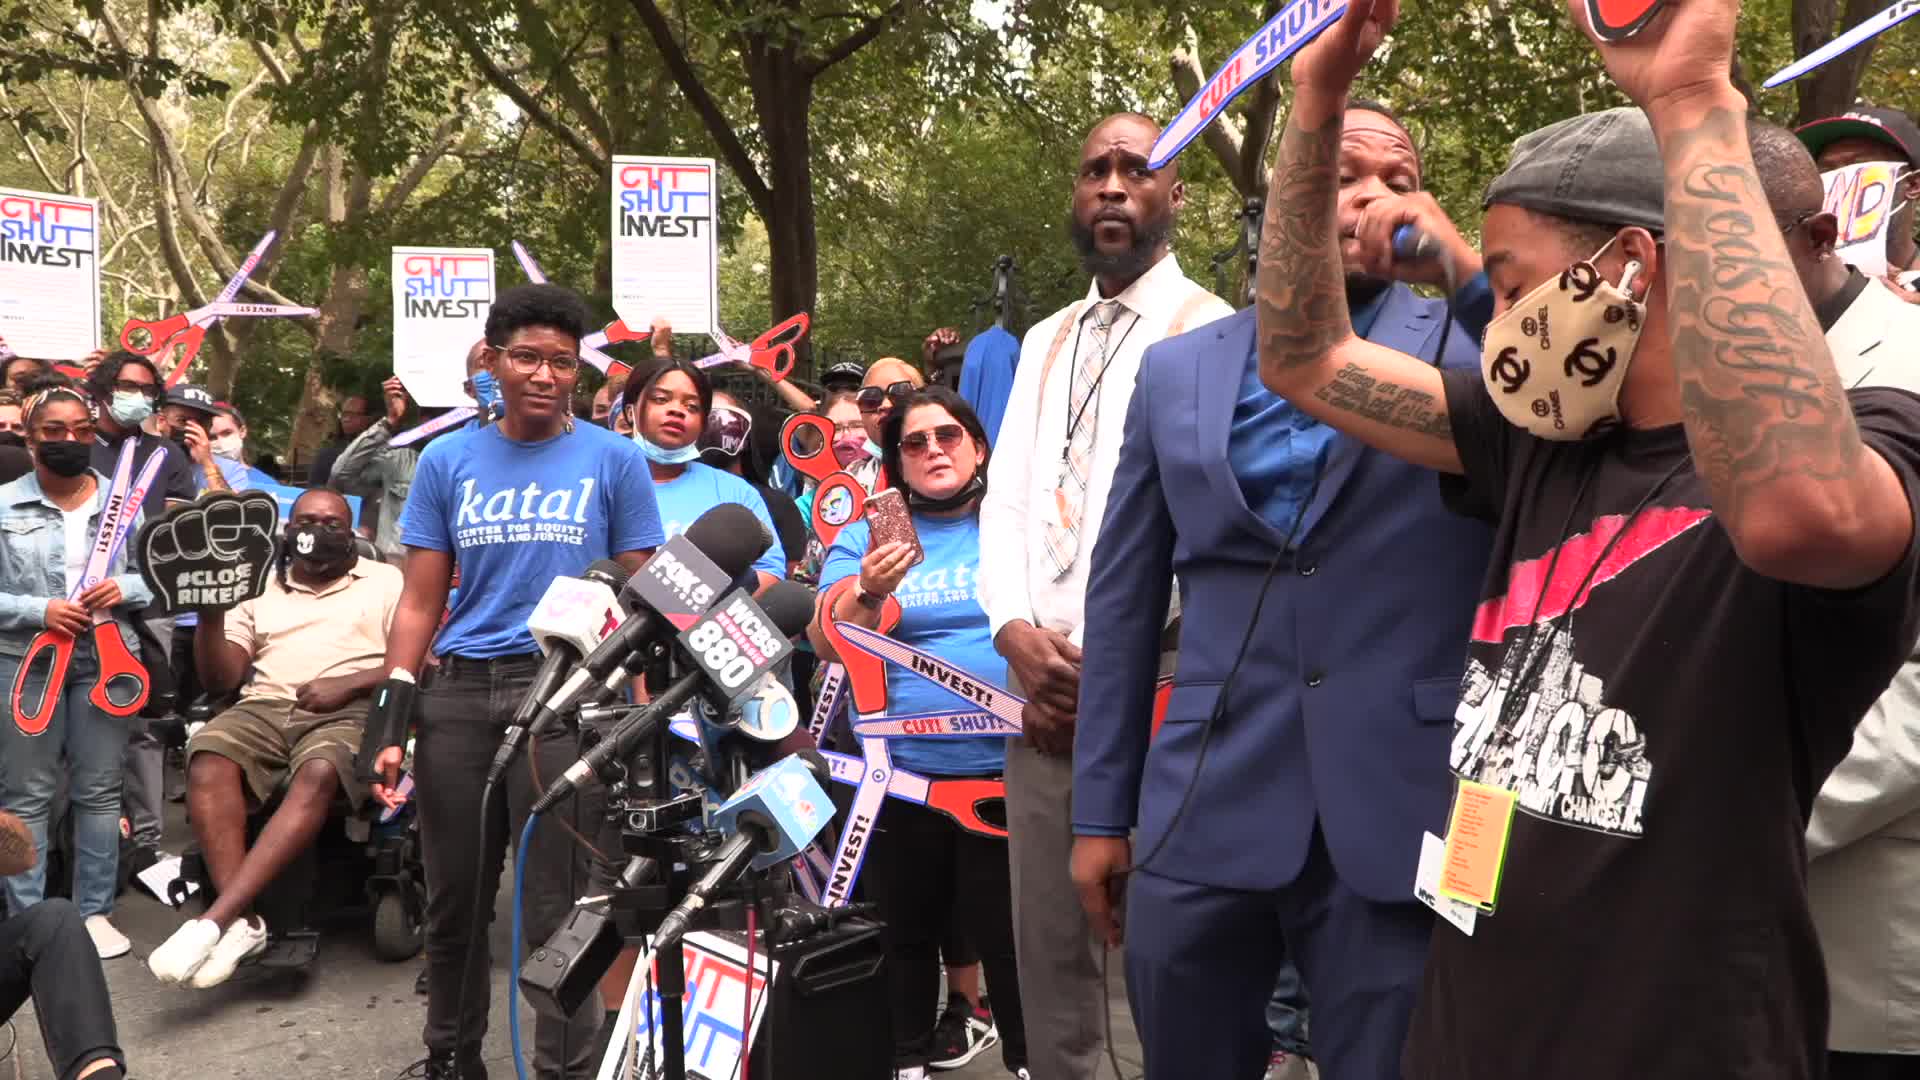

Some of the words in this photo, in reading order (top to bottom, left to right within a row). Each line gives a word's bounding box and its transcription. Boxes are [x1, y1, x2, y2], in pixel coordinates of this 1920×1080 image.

[1200, 57, 1242, 120] CUT!
[620, 180, 708, 213] SHUT
[1, 213, 93, 246] SHUT
[620, 206, 710, 238] INVEST
[1, 233, 93, 268] INVEST
[405, 269, 488, 297] SHUT
[405, 291, 490, 319] INVEST
[1538, 303, 1551, 351] CHANEL
[457, 478, 596, 527] katal
[96, 494, 123, 553] INVEST!
[457, 525, 502, 540] CENTER
[507, 523, 531, 534] FOR
[507, 532, 533, 545] AND
[532, 533, 584, 545] JUSTICE
[652, 550, 702, 595] FOX
[724, 598, 782, 658] WCBS
[688, 620, 754, 688] 880
[911, 655, 993, 707] INVEST!
[902, 718, 944, 735] CUT!
[827, 814, 870, 898] INVEST!
